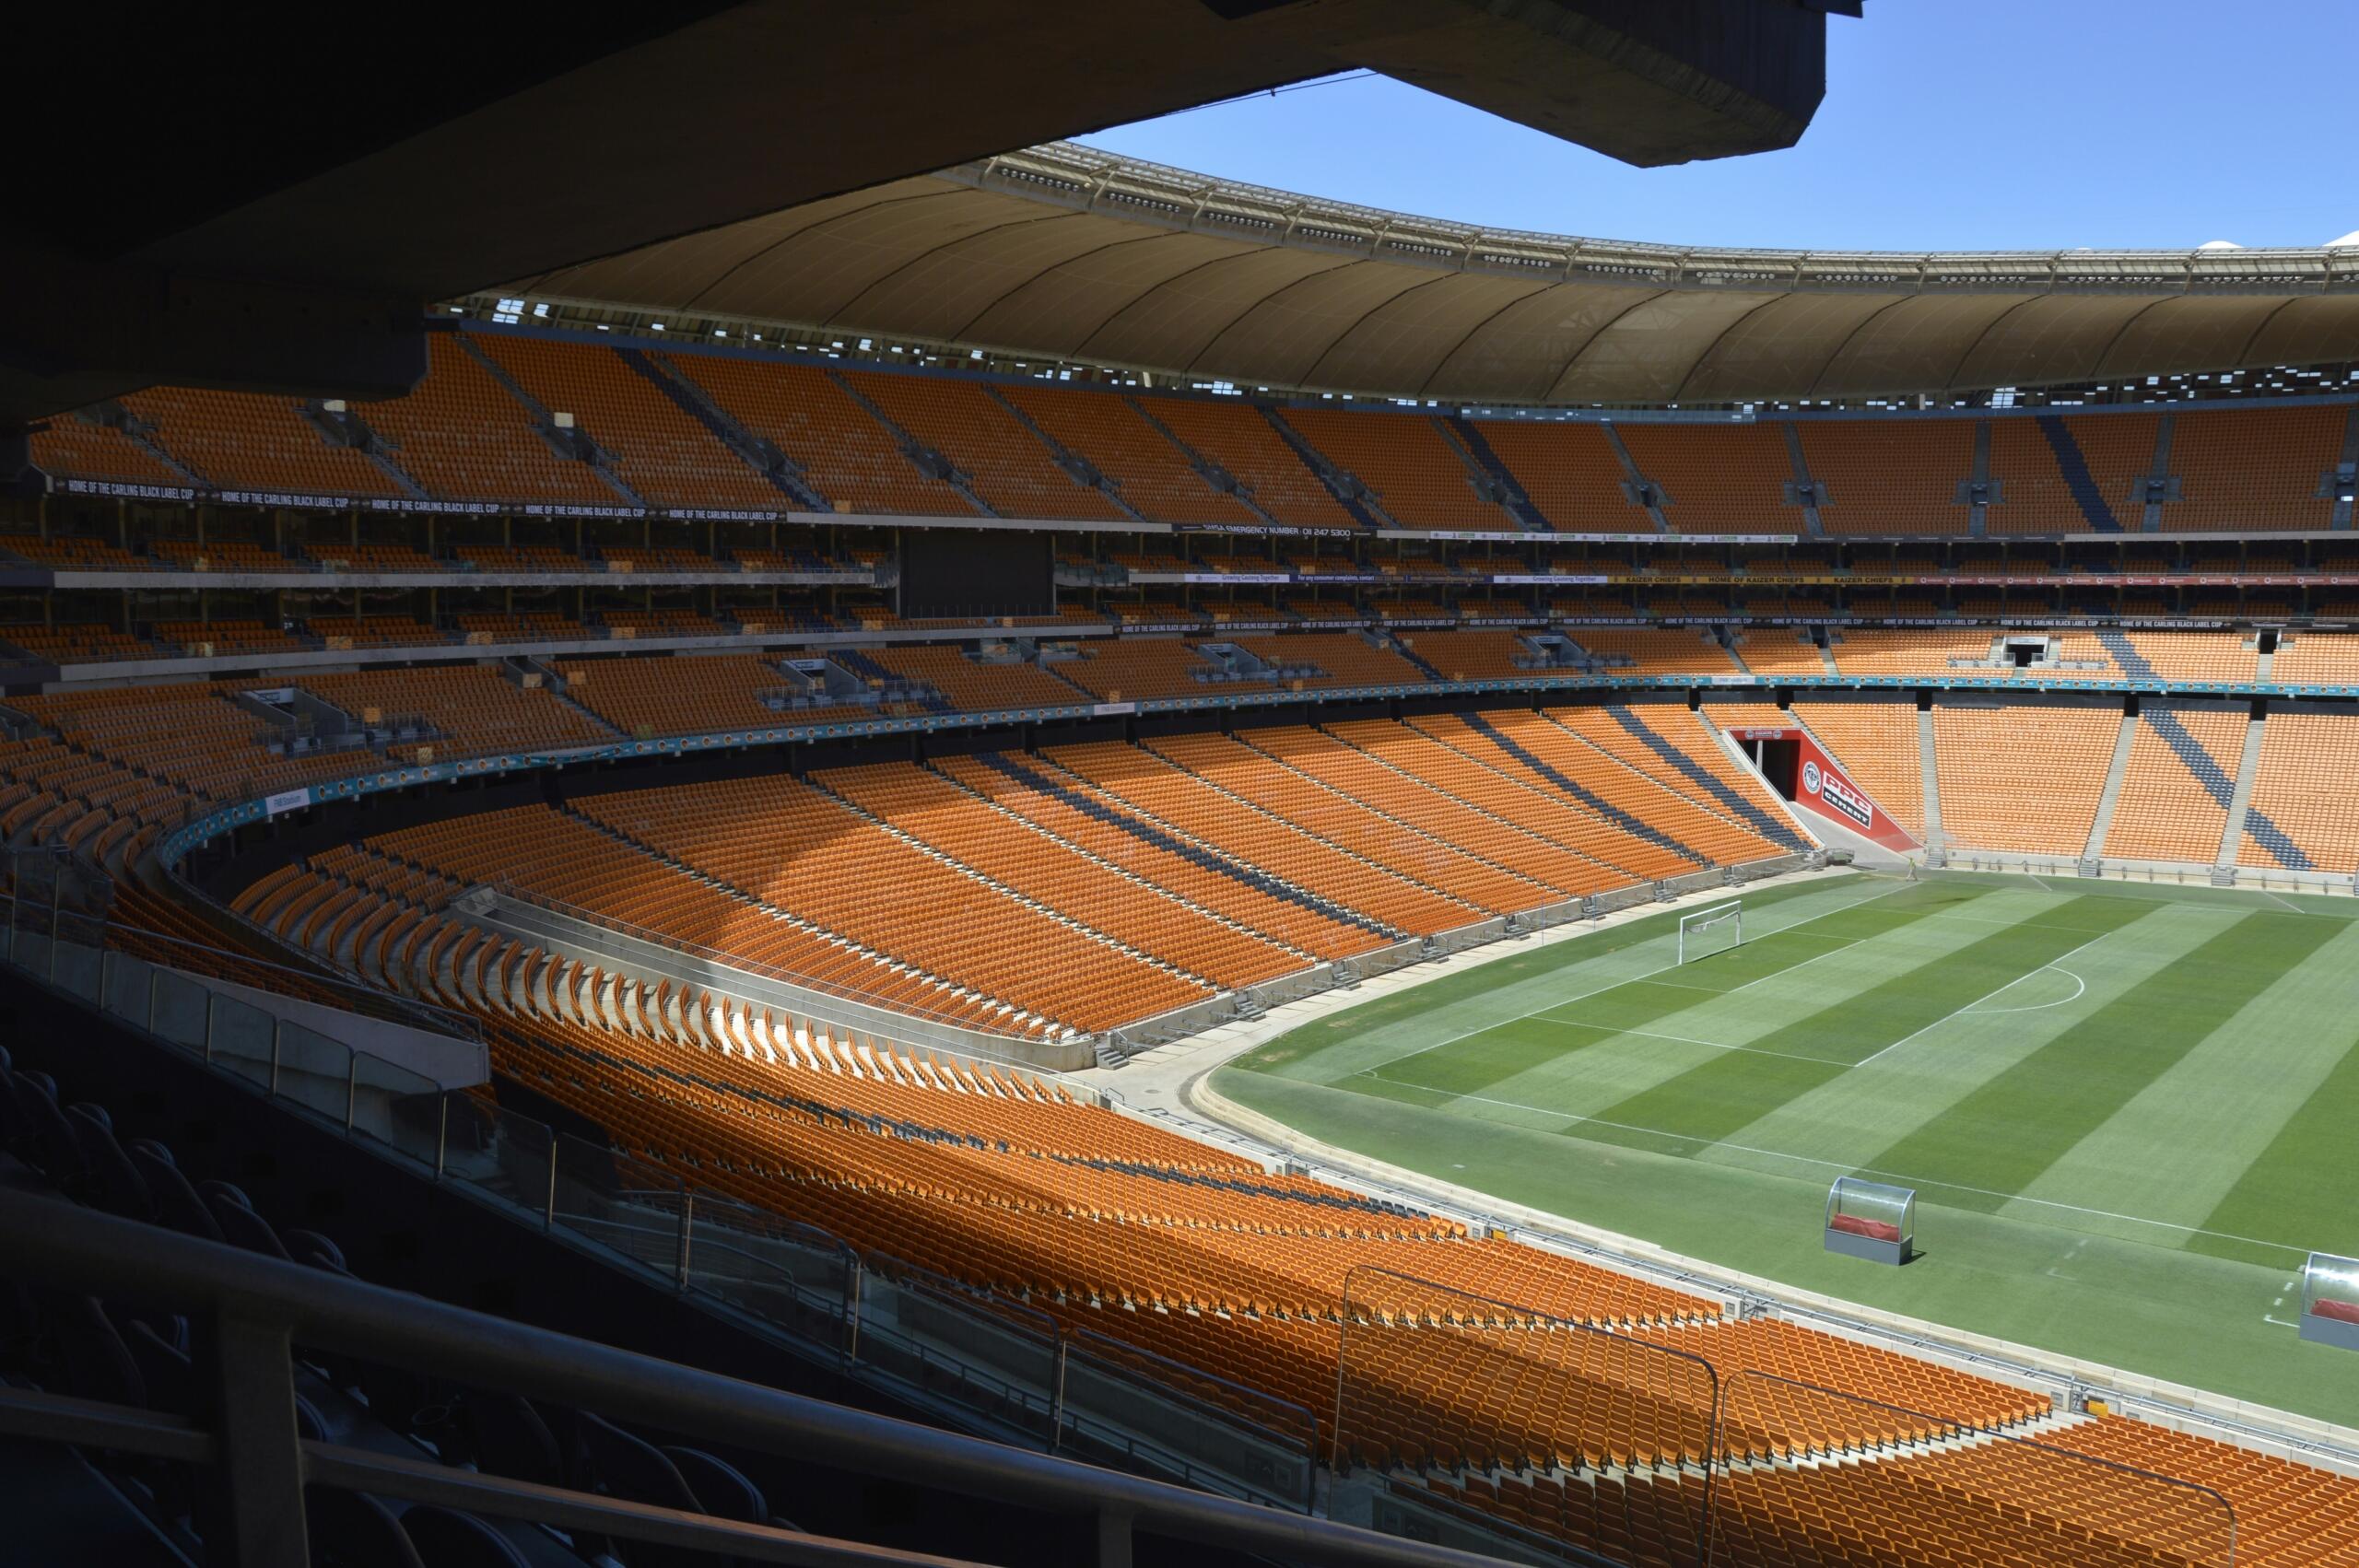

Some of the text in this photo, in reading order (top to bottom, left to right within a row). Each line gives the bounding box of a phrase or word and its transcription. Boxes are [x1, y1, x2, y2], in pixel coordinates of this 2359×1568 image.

[69, 480, 194, 500] HOME OF THE CARLING BLACK LABEL CUP
[222, 491, 349, 508] HOME OF THE CARLING BLACK LABEL CUP
[372, 500, 499, 513] HOME OF THE CARLING BLACK LABEL CUP
[526, 505, 645, 517] HOME OF THE CARLING BLACK LABEL CUP
[670, 510, 685, 518] HOME
[686, 510, 693, 518] OF
[695, 510, 705, 519] THE
[706, 510, 729, 519] CARLING
[731, 511, 748, 519] BLACK
[749, 512, 764, 520] LABEL
[1226, 525, 1268, 534] EMERGENCY
[1826, 775, 1869, 811] PPC
[1825, 792, 1868, 823] CEMENT
